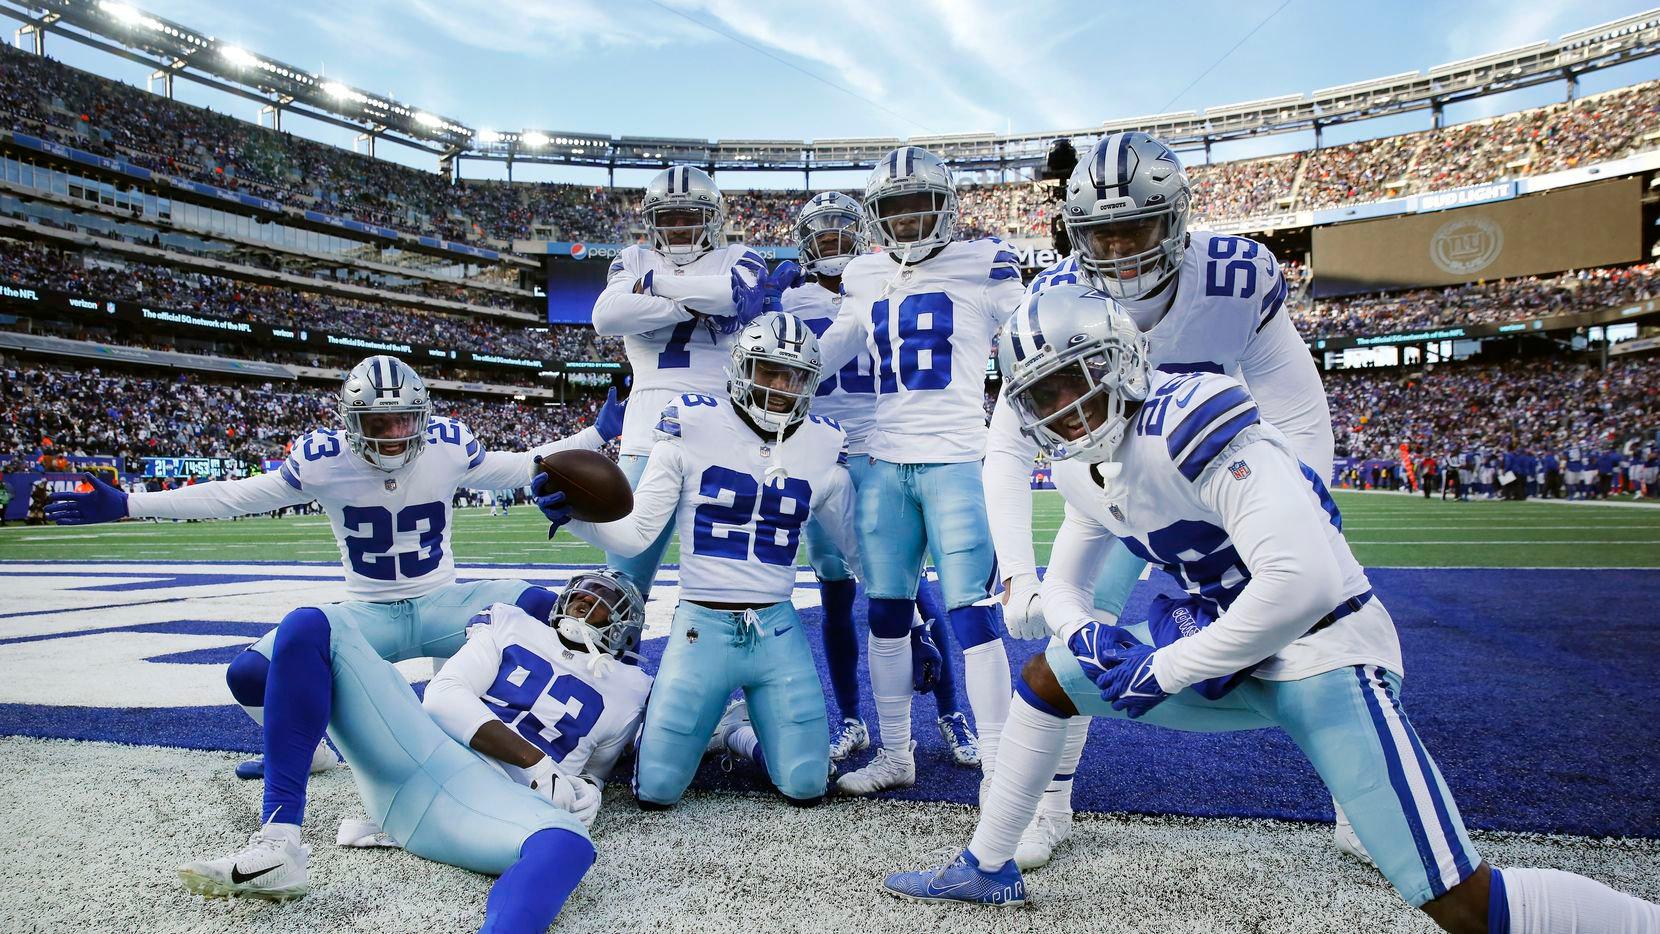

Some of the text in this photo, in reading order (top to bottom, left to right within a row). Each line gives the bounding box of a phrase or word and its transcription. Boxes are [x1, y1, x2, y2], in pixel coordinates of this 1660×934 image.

[1100, 202, 1126, 211] COWBOYS
[588, 247, 622, 259] peps
[1207, 237, 1258, 298] 59
[4, 287, 19, 297] the
[69, 299, 98, 310] verizon
[142, 309, 155, 318] The
[192, 318, 219, 327] network
[227, 322, 237, 330] the
[871, 291, 954, 392] 18
[427, 418, 460, 446] 2
[693, 465, 813, 566] 28
[342, 501, 447, 581] 23
[480, 643, 606, 764] 93
